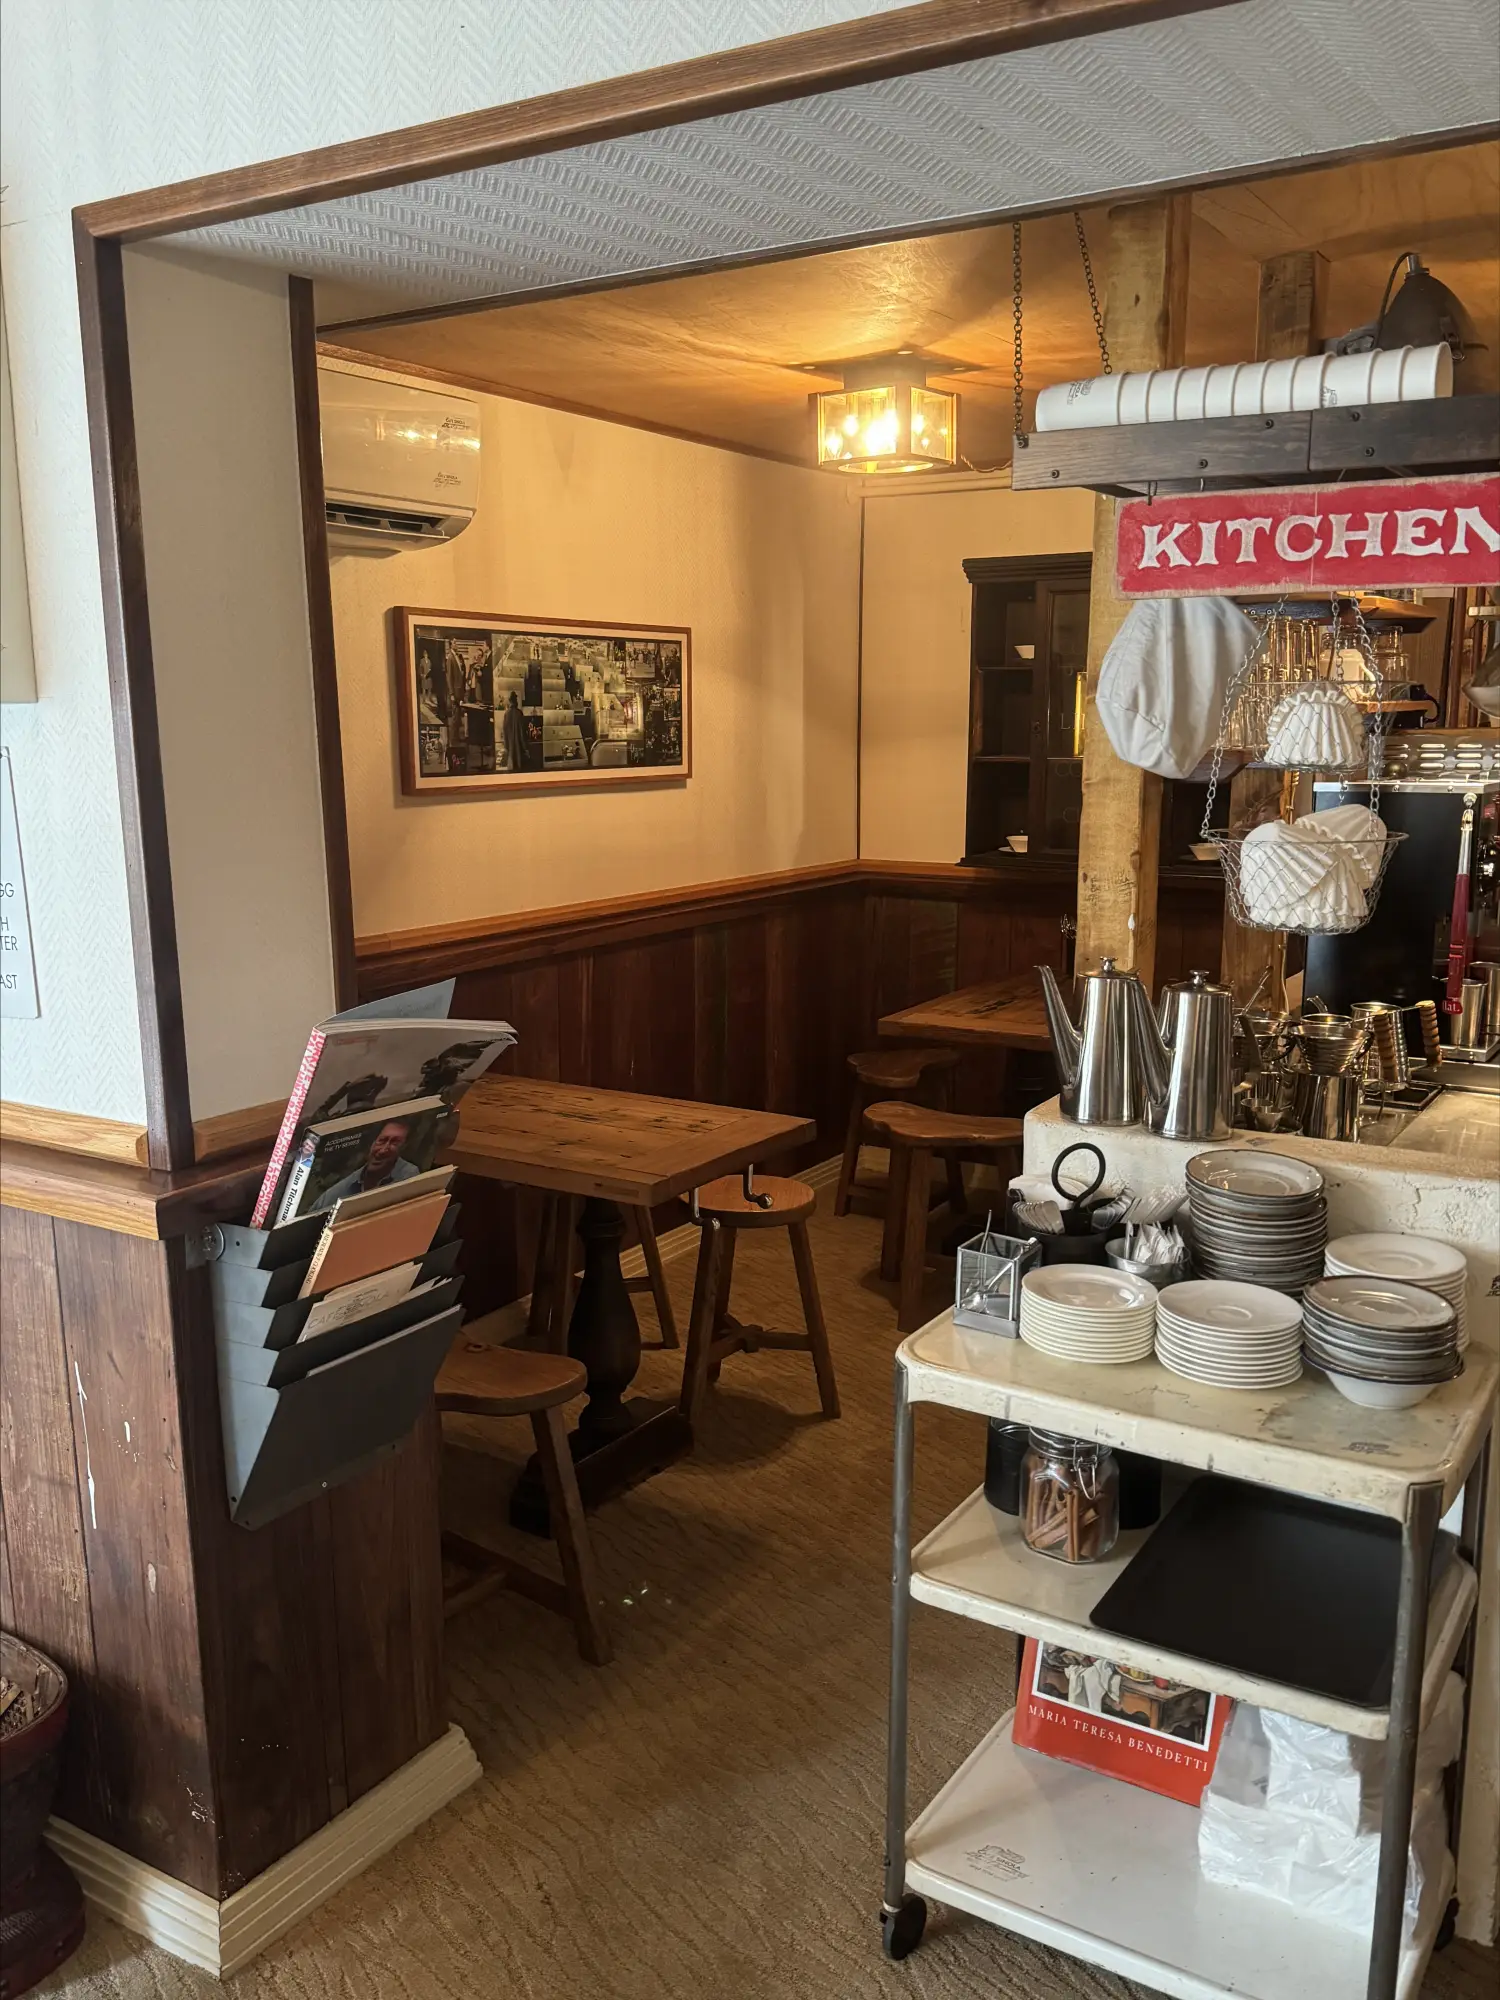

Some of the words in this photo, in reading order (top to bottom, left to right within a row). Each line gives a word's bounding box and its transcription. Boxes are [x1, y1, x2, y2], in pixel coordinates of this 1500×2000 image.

[1138, 507, 1500, 570] KITCHEN
[285, 1083, 309, 1136] JAMAICA
[276, 1137, 291, 1166] PERU
[292, 1166, 304, 1186] Alan
[1028, 1704, 1067, 1726] MARIA
[1073, 1719, 1123, 1744] TERESA
[1128, 1738, 1209, 1772] BENEDETTI
